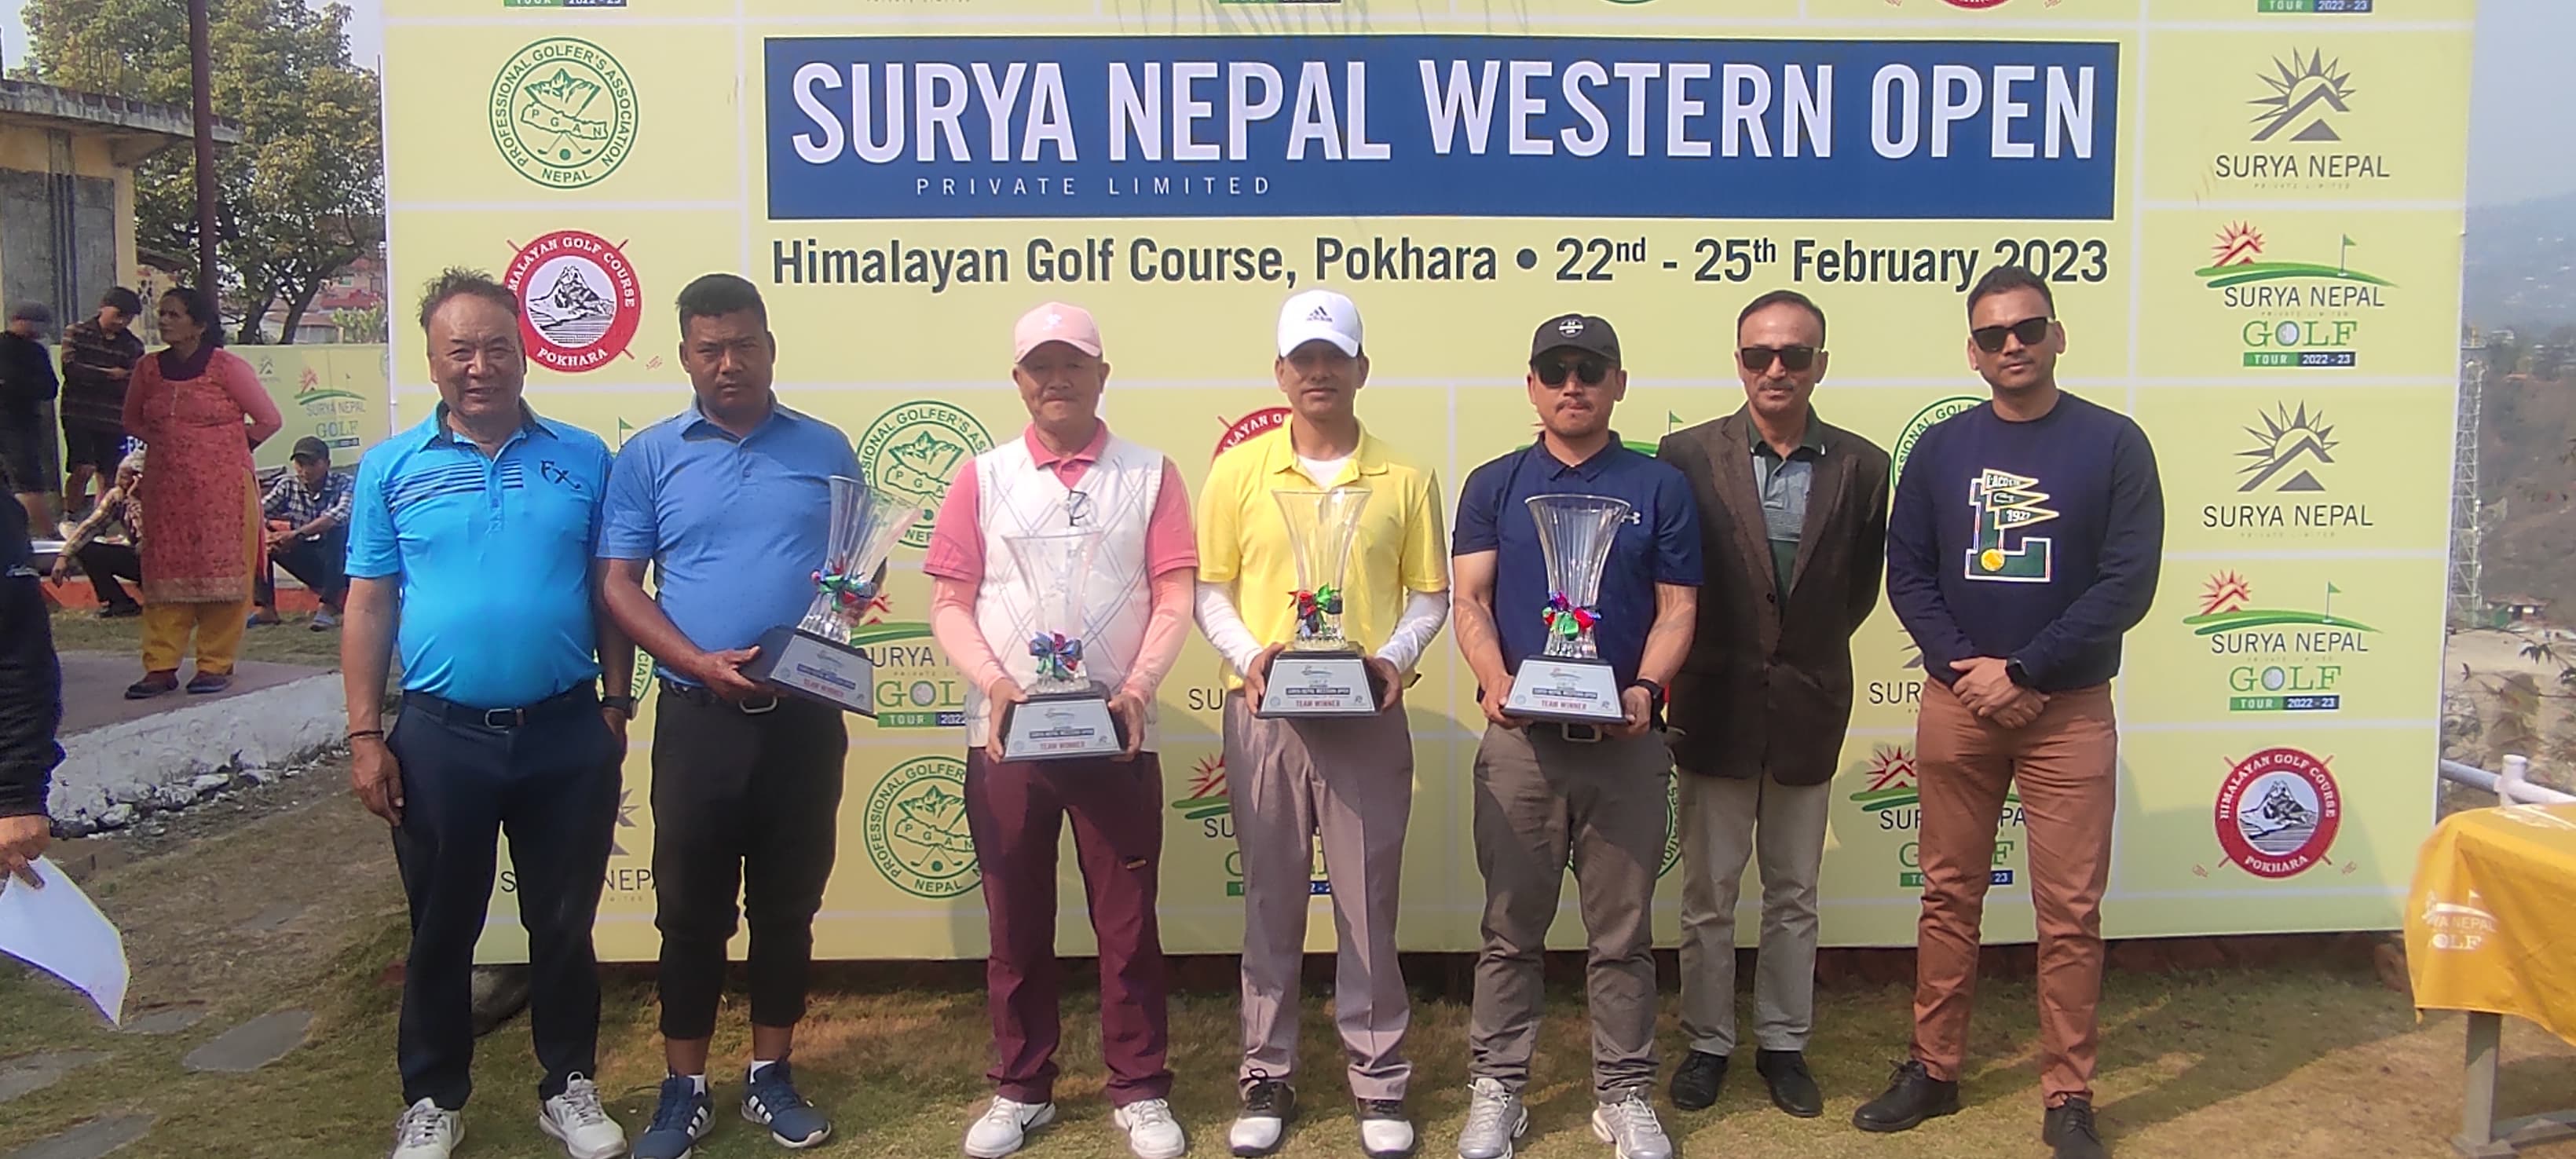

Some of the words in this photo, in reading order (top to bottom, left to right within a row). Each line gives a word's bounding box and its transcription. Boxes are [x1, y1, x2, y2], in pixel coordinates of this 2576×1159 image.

[2269, 0, 2303, 10] TOUR
[496, 60, 532, 167] PROFESSIONAL
[532, 45, 607, 71] GOLFER'S
[602, 70, 632, 166] ASSOCIATION
[792, 61, 1078, 164] SURYA
[1108, 61, 1391, 161] NEPAL
[1419, 60, 1833, 158] WESTERN
[1870, 64, 2095, 159] OPEN
[542, 167, 592, 184] NEPAL
[2216, 155, 2298, 177] SURYA
[2309, 155, 2390, 177] NEPAL
[917, 177, 1075, 196] PRIVATE
[1109, 176, 1271, 196] LIMITED
[508, 239, 558, 293] MALAYAN
[562, 236, 602, 254] GOLF
[603, 252, 635, 308] COURSE
[773, 239, 1008, 294] Himalayan
[1026, 237, 1114, 283] Golf
[1129, 238, 1297, 289] Course,
[1316, 237, 1497, 282] Pokhara
[1556, 237, 1647, 282] 22nd
[1694, 237, 1777, 282] 25th
[1793, 239, 1980, 293] February
[1994, 239, 2108, 282] 2023
[2224, 286, 2300, 307] SURYA
[2310, 286, 2385, 307] NEPAL
[2242, 320, 2358, 347] GOLF
[536, 347, 609, 367] POKHARA
[2254, 354, 2288, 364] TOUR
[316, 420, 358, 438] GOLF
[1224, 415, 1268, 451] LAYAN
[862, 422, 896, 479] SSIONAL
[897, 408, 971, 433] GOLFER'S
[2203, 505, 2284, 528] SURYA
[2294, 504, 2374, 527] NEPAL
[905, 528, 932, 542] NEP
[2212, 633, 2286, 654] SURYA
[2296, 632, 2369, 653] NEPAL
[871, 646, 935, 667] URYA
[2229, 665, 2341, 692] GOLF
[876, 680, 967, 707] GOL
[1868, 682, 1922, 704] SUR
[2240, 698, 2274, 709] TOUR
[890, 715, 924, 724] TOUR
[2220, 755, 2270, 821] HIMALAYAN
[2274, 754, 2310, 769] GOLF
[2309, 766, 2336, 818] COURSE
[870, 777, 905, 878] PROFESSIONAL
[906, 763, 965, 781] GOLFER
[2245, 855, 2308, 873] POKHARA
[605, 869, 657, 891] NEP
[914, 879, 963, 893] NEPAL
[2428, 933, 2483, 950] OLF
